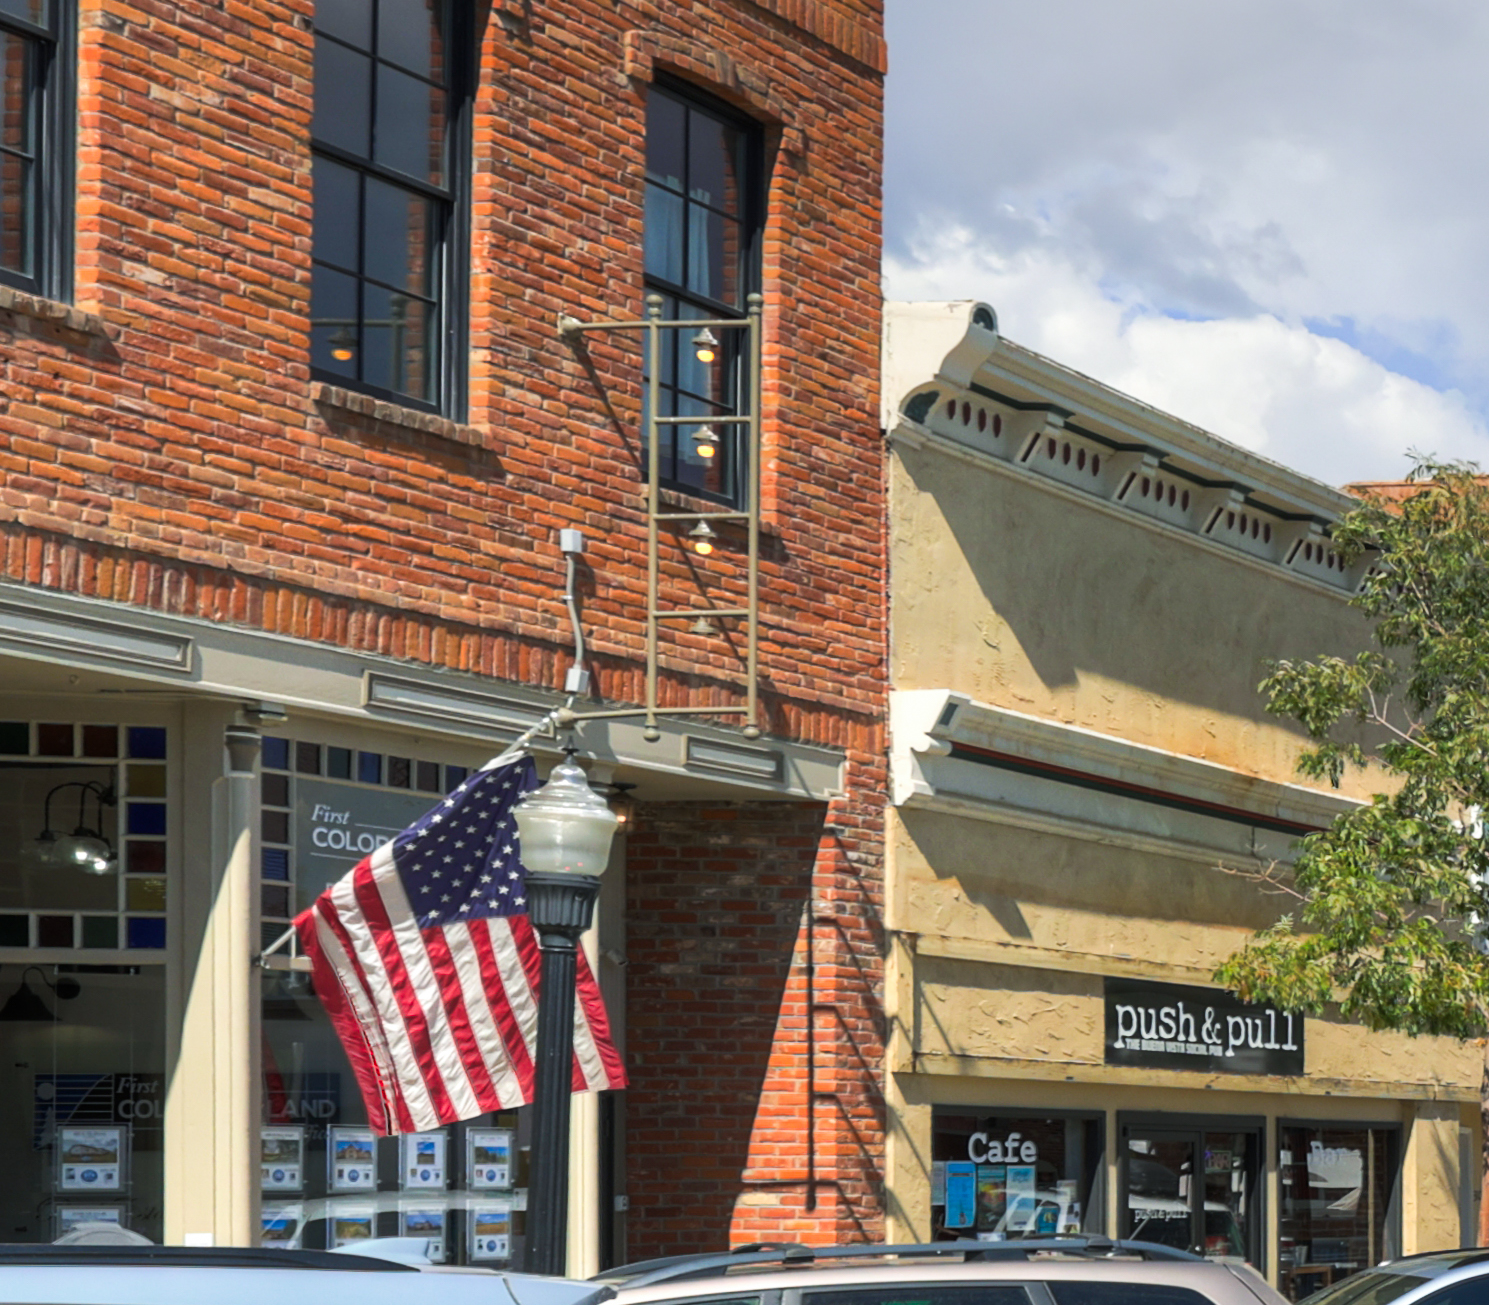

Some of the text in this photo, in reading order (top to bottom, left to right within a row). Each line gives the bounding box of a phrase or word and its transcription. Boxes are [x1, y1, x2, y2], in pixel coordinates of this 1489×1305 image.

[311, 804, 351, 825] First
[117, 1076, 158, 1094] First
[968, 1132, 1037, 1164] Cafe
